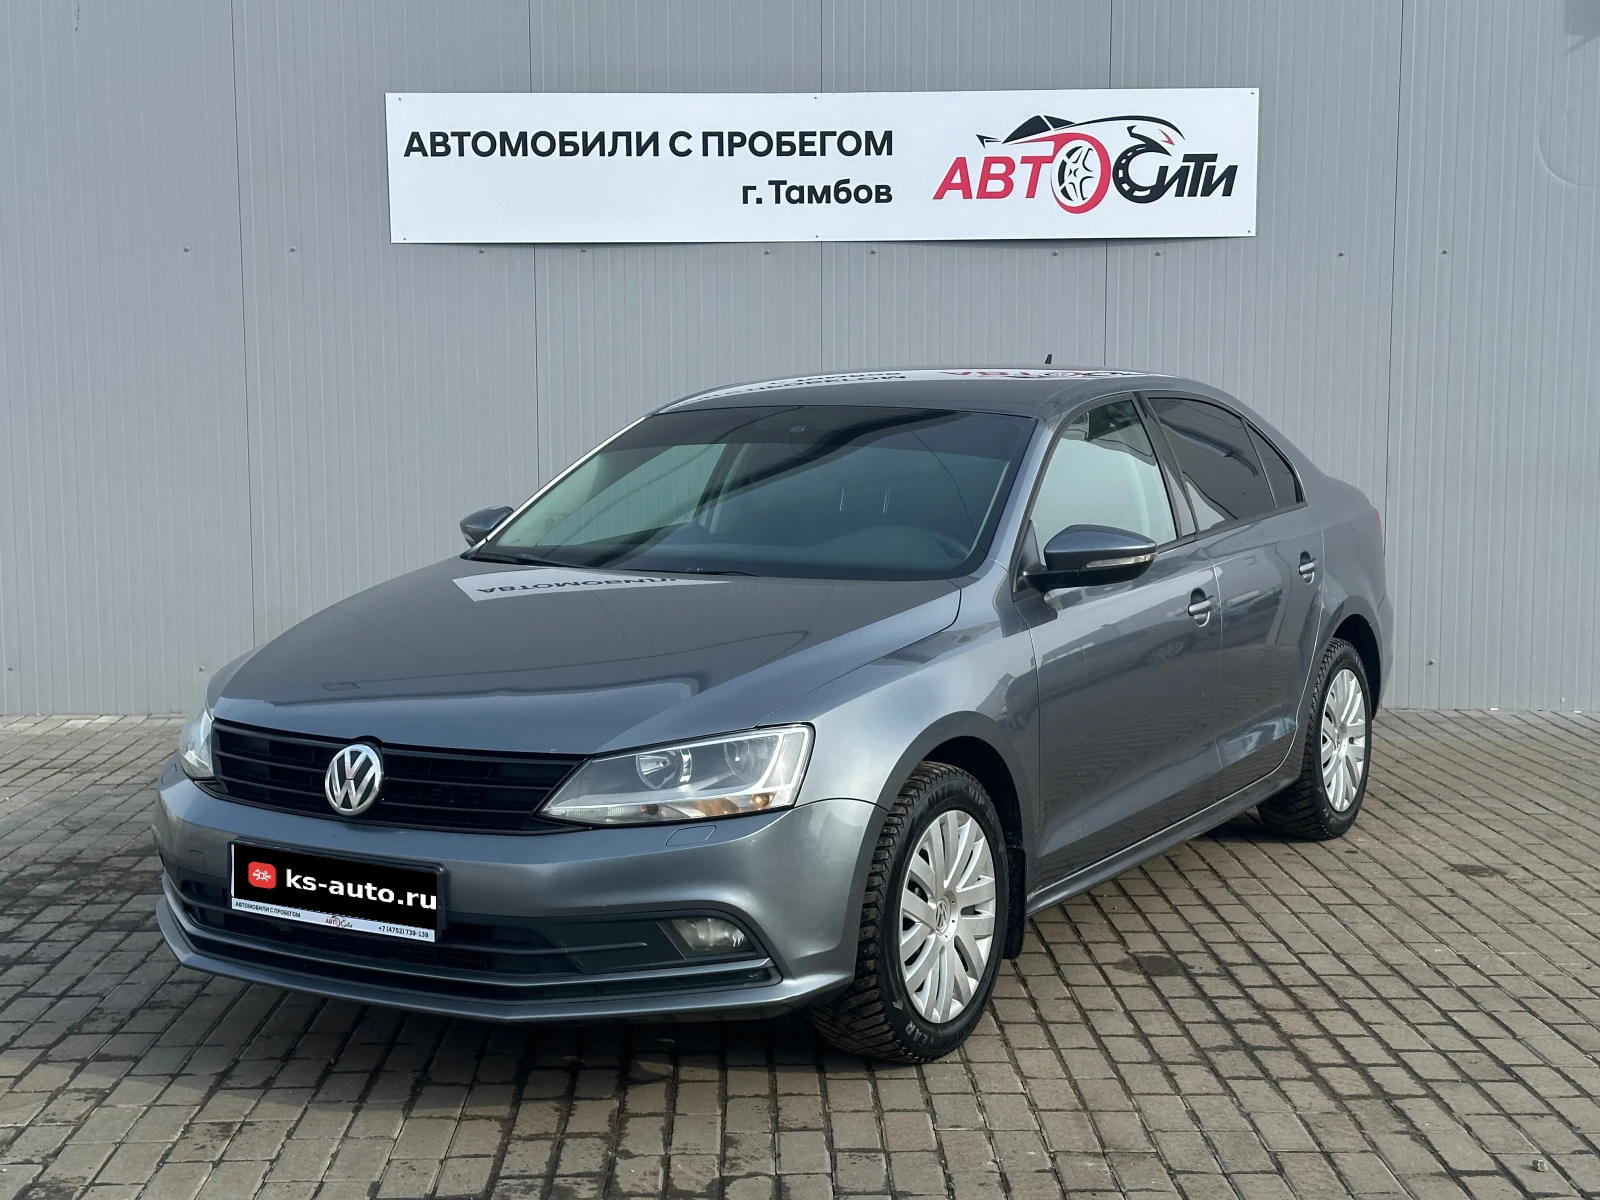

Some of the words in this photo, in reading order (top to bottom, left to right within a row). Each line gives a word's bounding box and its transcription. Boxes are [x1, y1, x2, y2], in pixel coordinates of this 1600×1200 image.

[403, 130, 660, 158] АВТОМОБИЛИ
[669, 131, 694, 157] С
[701, 130, 894, 158] ПРОБЕГОМ
[741, 183, 763, 205] г.
[767, 178, 893, 205] Тамбов
[235, 901, 269, 913] АВТОМОБИЛИ
[274, 908, 301, 918] ПРОБЕГОМ
